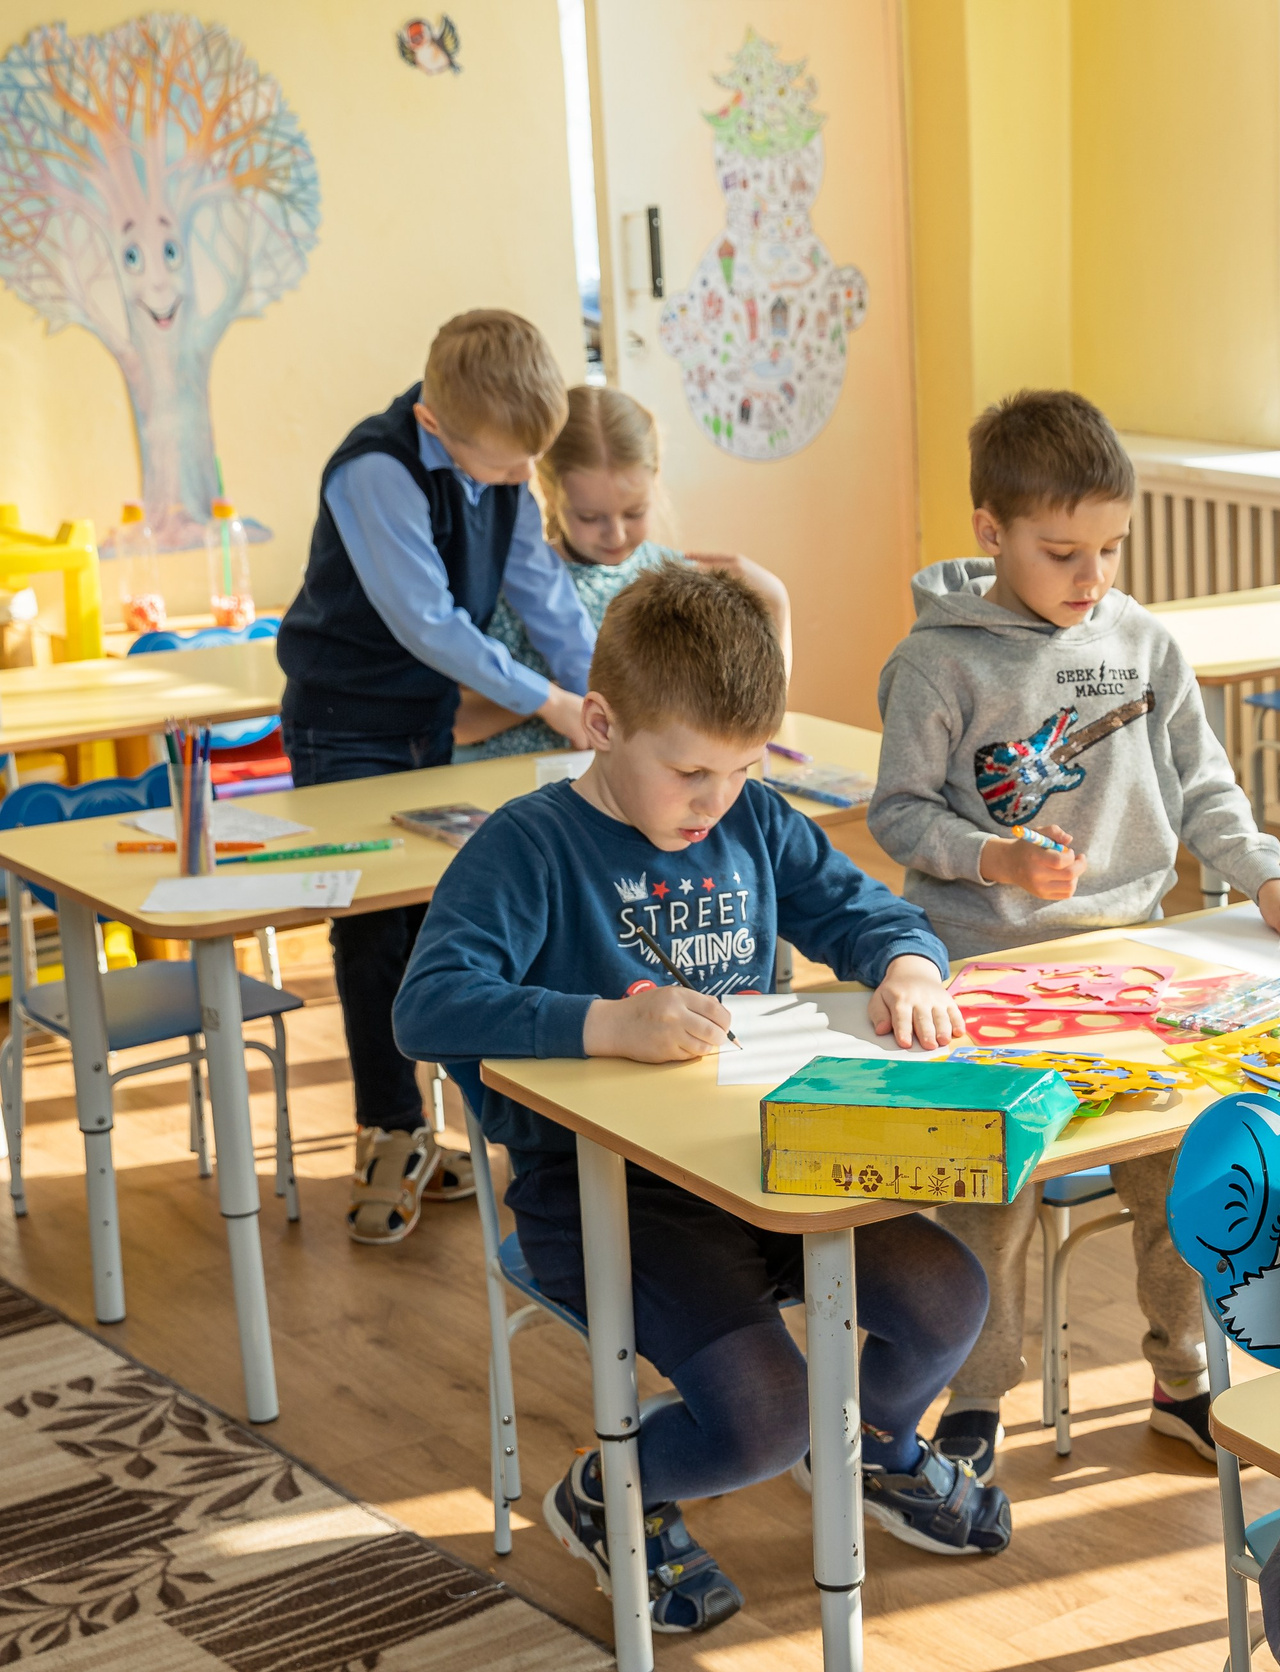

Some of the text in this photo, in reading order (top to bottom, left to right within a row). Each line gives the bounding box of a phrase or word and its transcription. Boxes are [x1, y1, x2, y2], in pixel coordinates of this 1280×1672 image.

[1057, 668, 1139, 684] SEEK THE
[1075, 683, 1126, 698] MAGIC
[619, 890, 749, 940] STREET
[671, 927, 756, 969] KING
